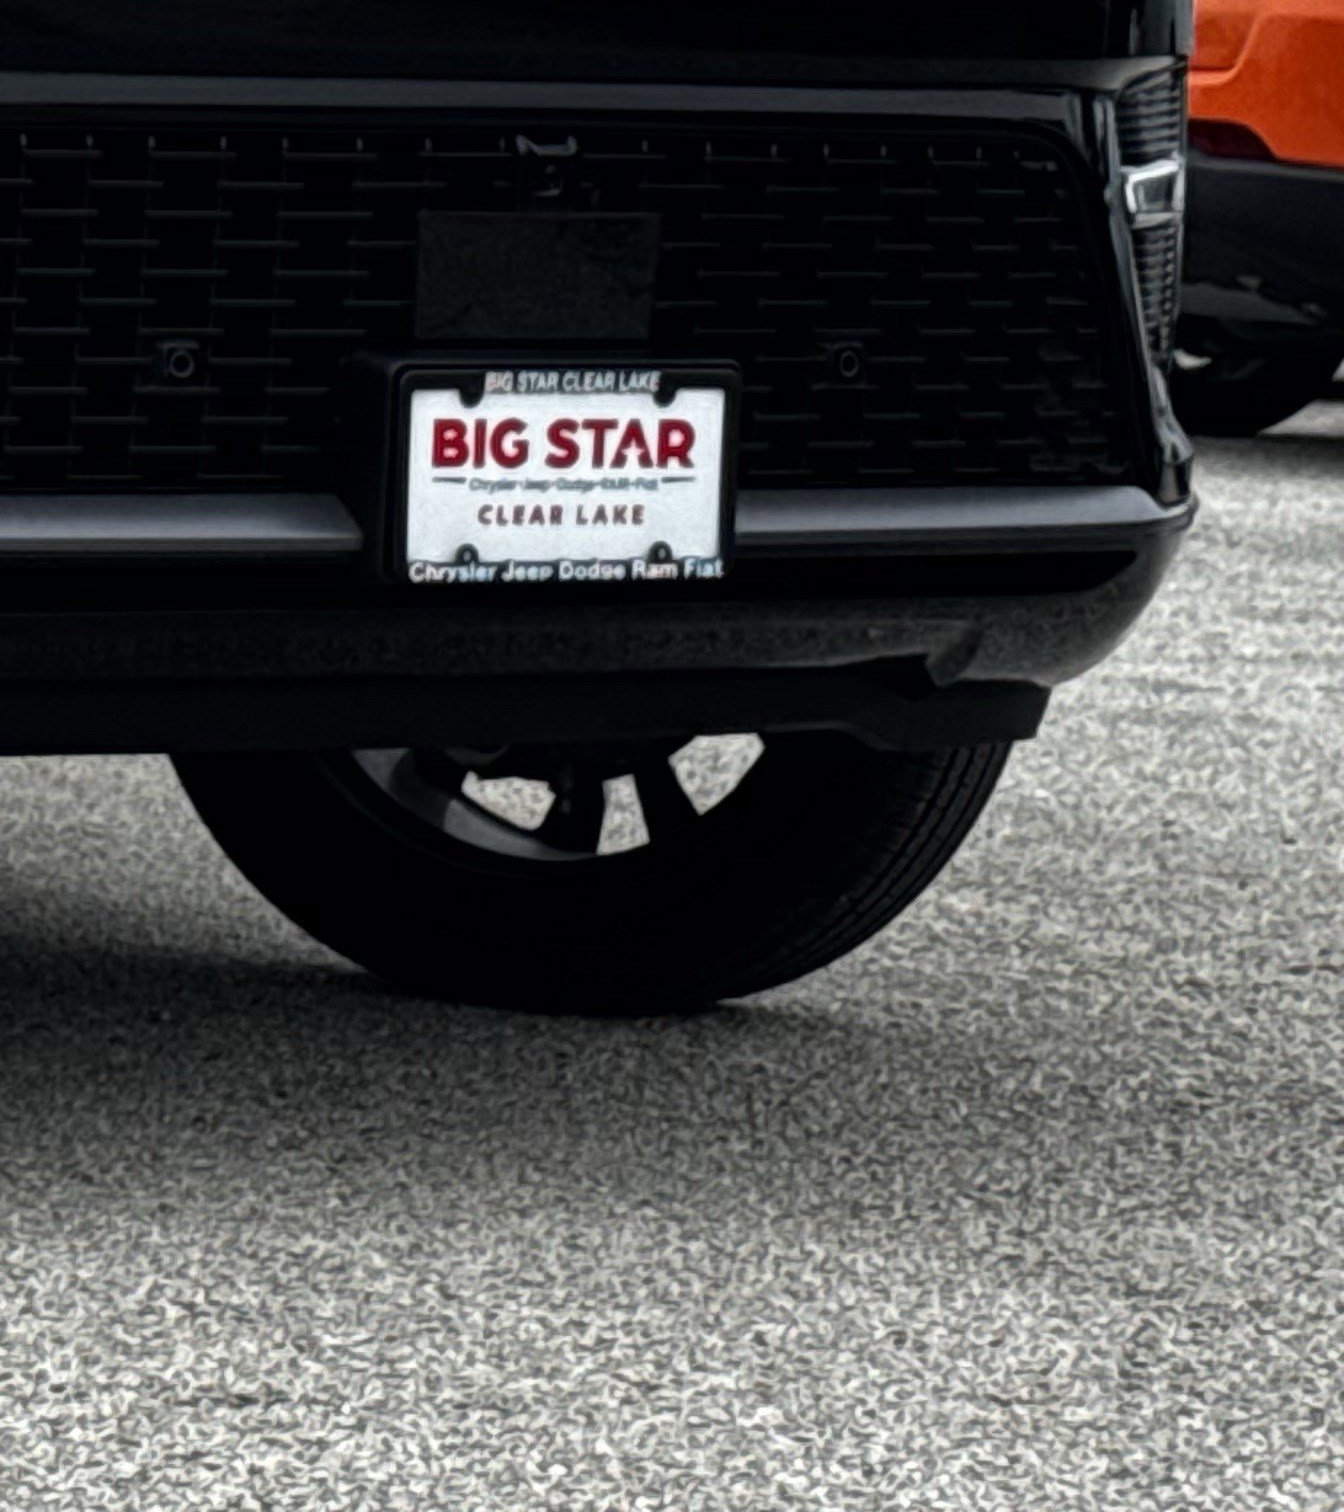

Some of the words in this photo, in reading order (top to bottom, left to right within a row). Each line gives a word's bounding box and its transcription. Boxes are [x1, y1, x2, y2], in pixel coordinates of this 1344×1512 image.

[485, 371, 514, 392] BIG
[517, 371, 560, 392] STAR
[562, 371, 616, 392] CLEAR
[619, 371, 662, 392] LAKE
[431, 417, 530, 469] BIG
[544, 417, 696, 469] STAR
[477, 503, 564, 527] CLEAR
[575, 503, 646, 527] LAKE
[409, 561, 498, 583] Chrysler
[501, 560, 554, 582] Jeep
[558, 558, 627, 581] Dodge
[631, 558, 679, 580] Ram
[683, 556, 725, 579] Fiat
